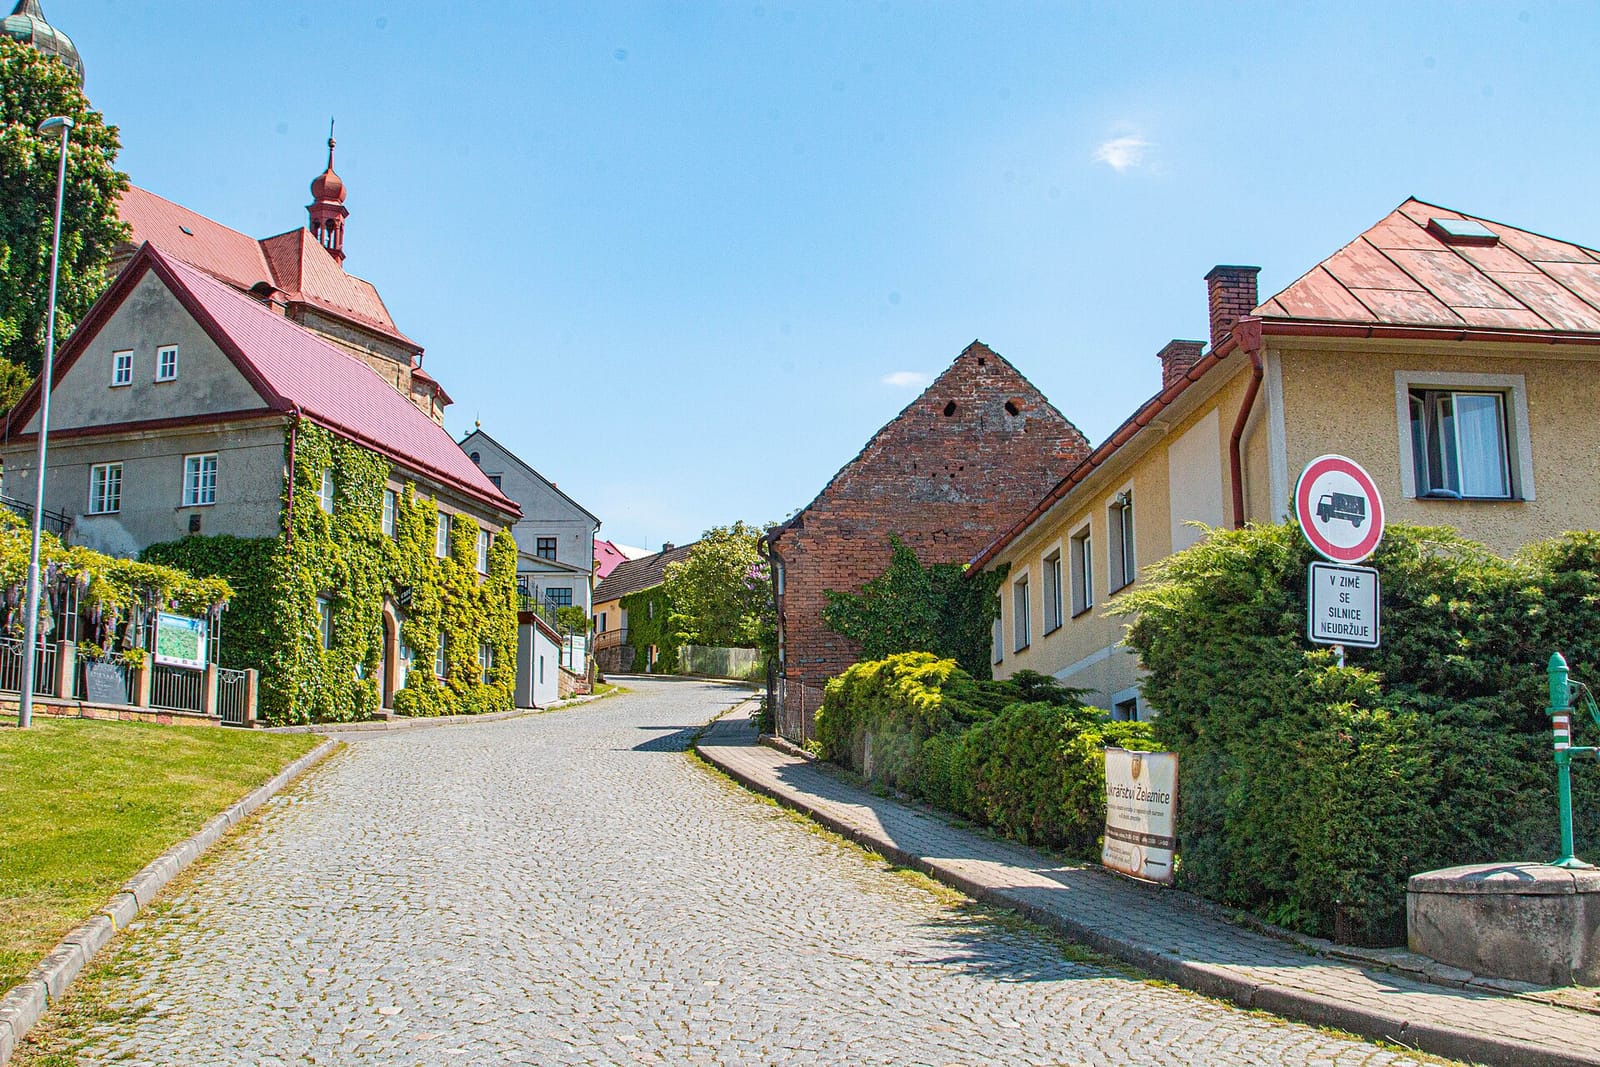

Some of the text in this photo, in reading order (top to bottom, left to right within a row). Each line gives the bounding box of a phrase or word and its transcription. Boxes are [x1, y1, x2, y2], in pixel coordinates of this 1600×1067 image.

[1330, 575, 1360, 588] V ZIMĚ
[1339, 592, 1350, 604] SE
[1328, 607, 1361, 620] SILNICE
[1321, 622, 1369, 636] NEUDRŽUJE
[1136, 783, 1170, 804] Železnice
